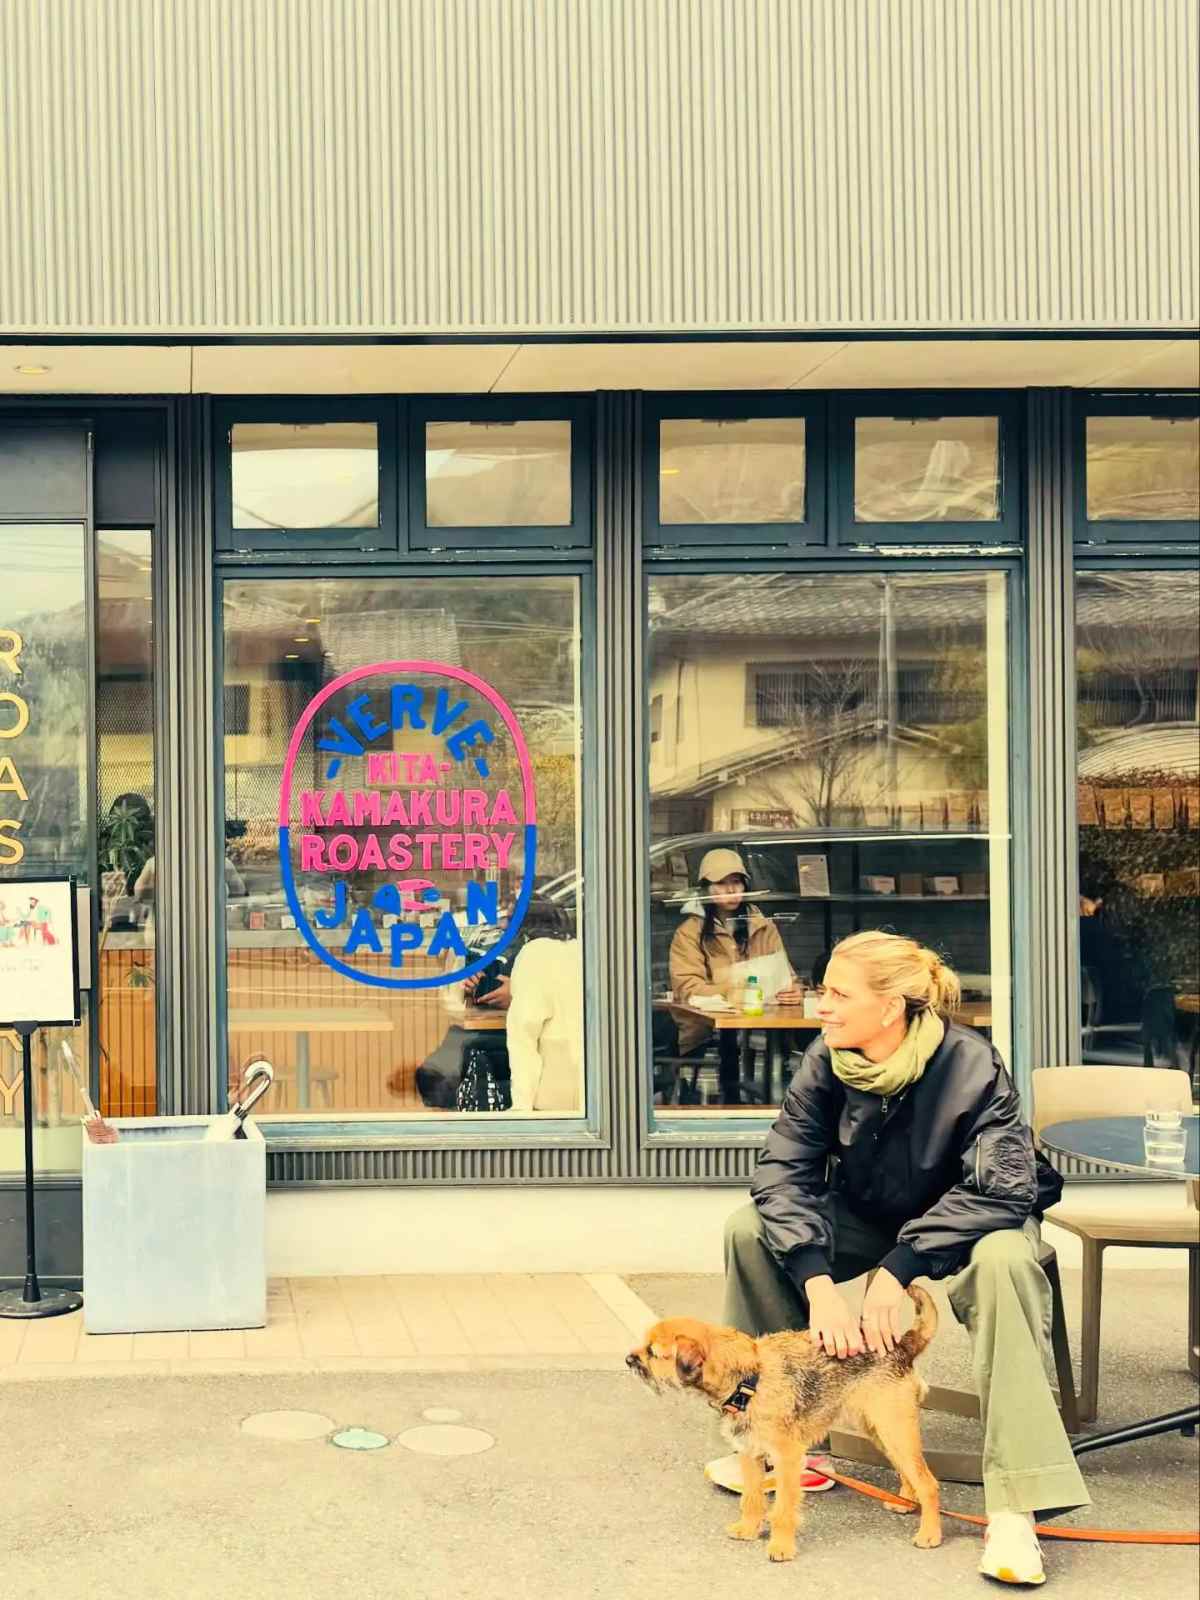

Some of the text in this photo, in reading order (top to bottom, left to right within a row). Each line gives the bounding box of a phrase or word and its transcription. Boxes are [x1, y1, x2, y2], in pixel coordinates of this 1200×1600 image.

[367, 752, 452, 785] KITA-
[300, 789, 519, 827] KAMAKURA
[301, 831, 516, 872] ROASTERY
[314, 879, 499, 968] JAPAN
